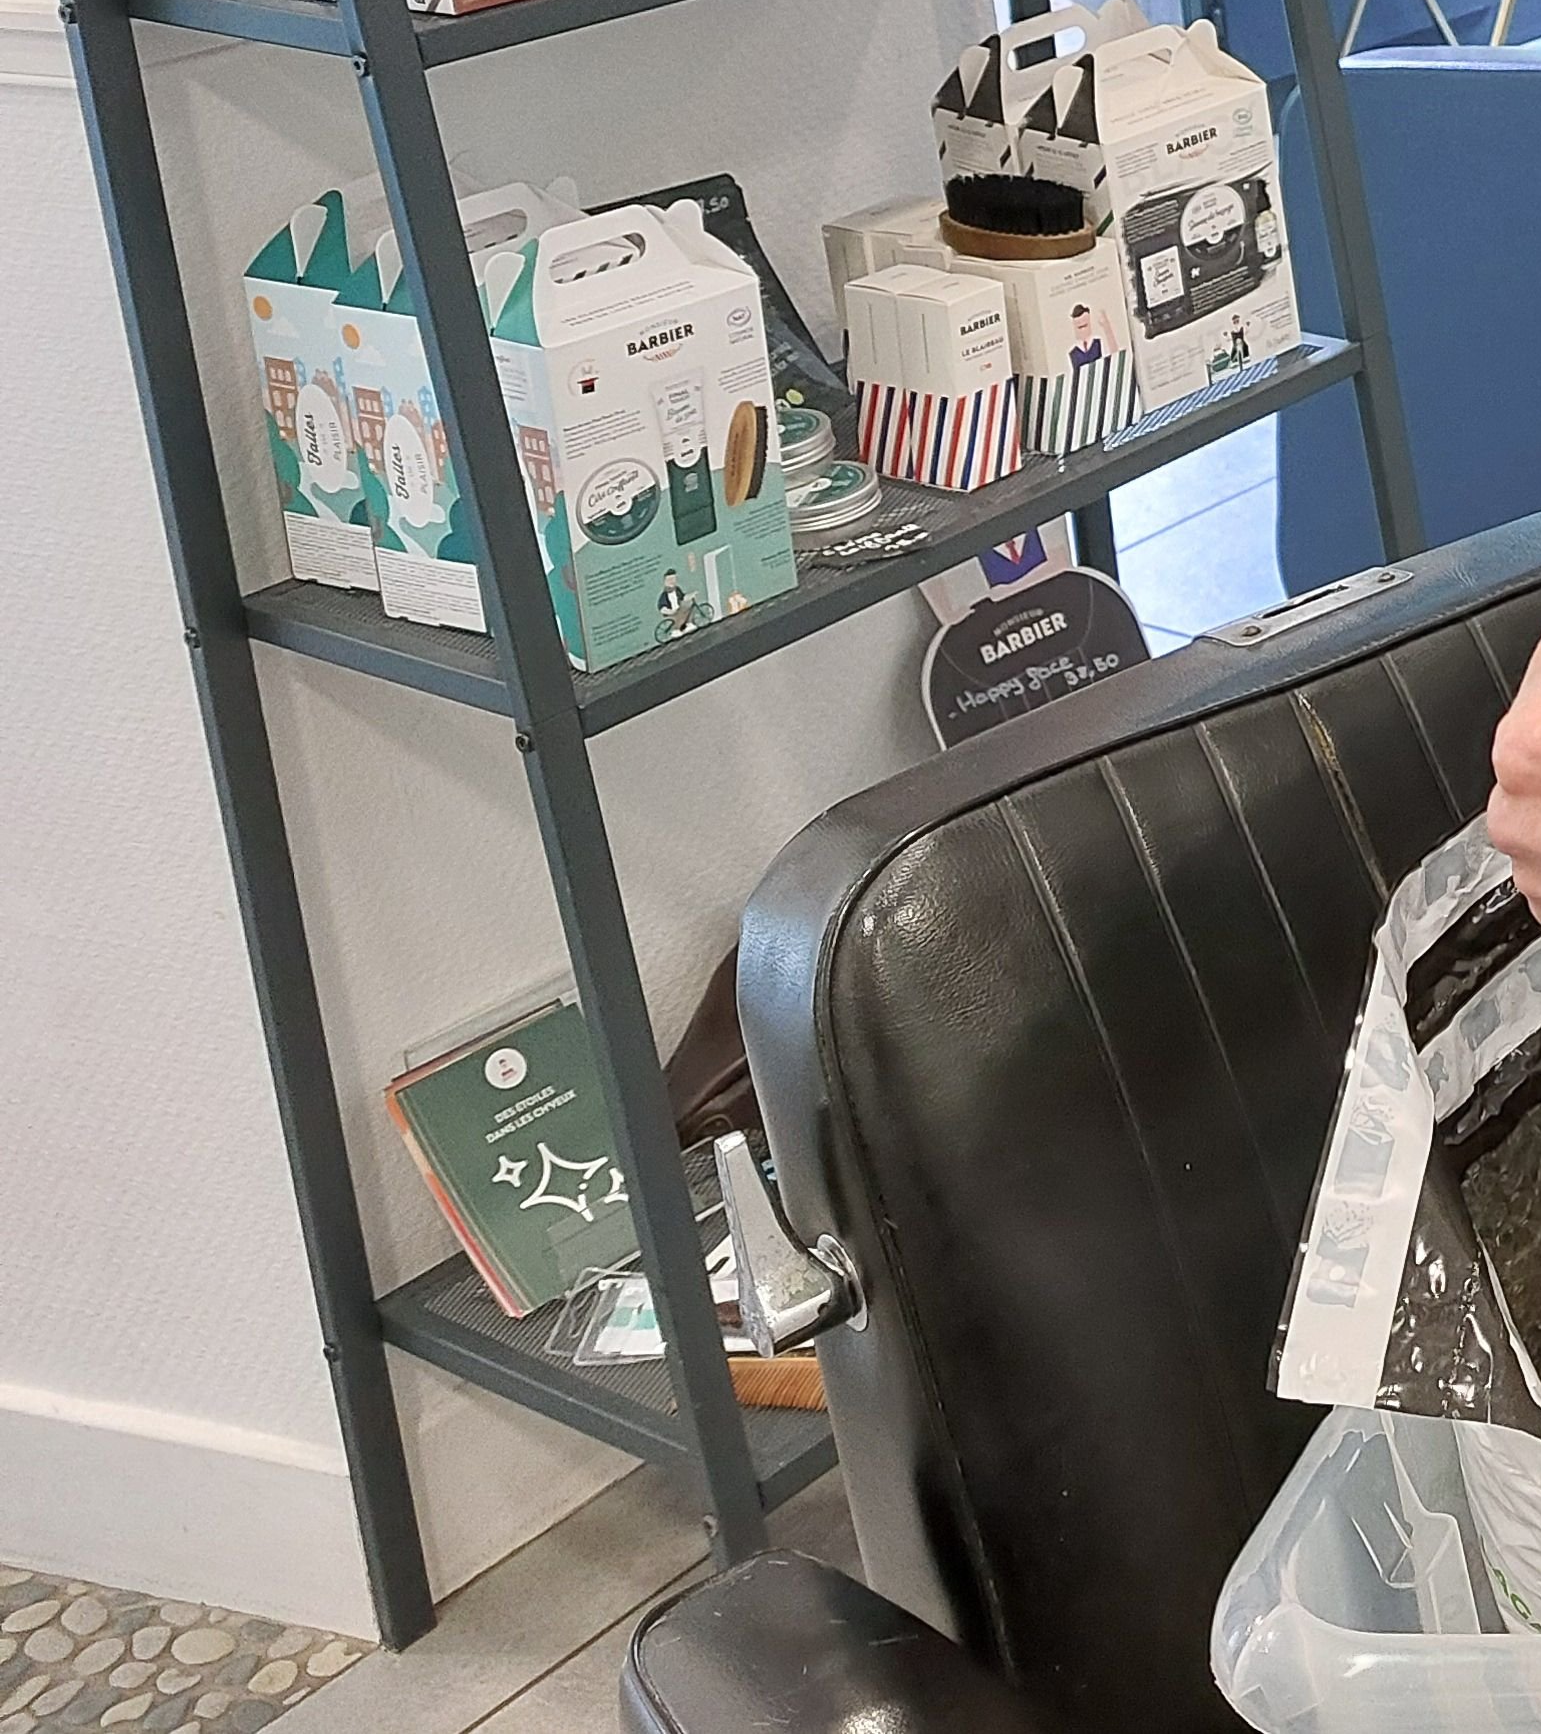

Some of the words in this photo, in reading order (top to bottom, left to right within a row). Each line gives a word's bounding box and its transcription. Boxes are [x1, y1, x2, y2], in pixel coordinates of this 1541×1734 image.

[1166, 127, 1218, 155] BARBIER
[626, 323, 695, 357] BARBIER
[960, 313, 1001, 336] BARBIER
[980, 613, 1068, 664] BARBIER
[956, 678, 1025, 712] Happy
